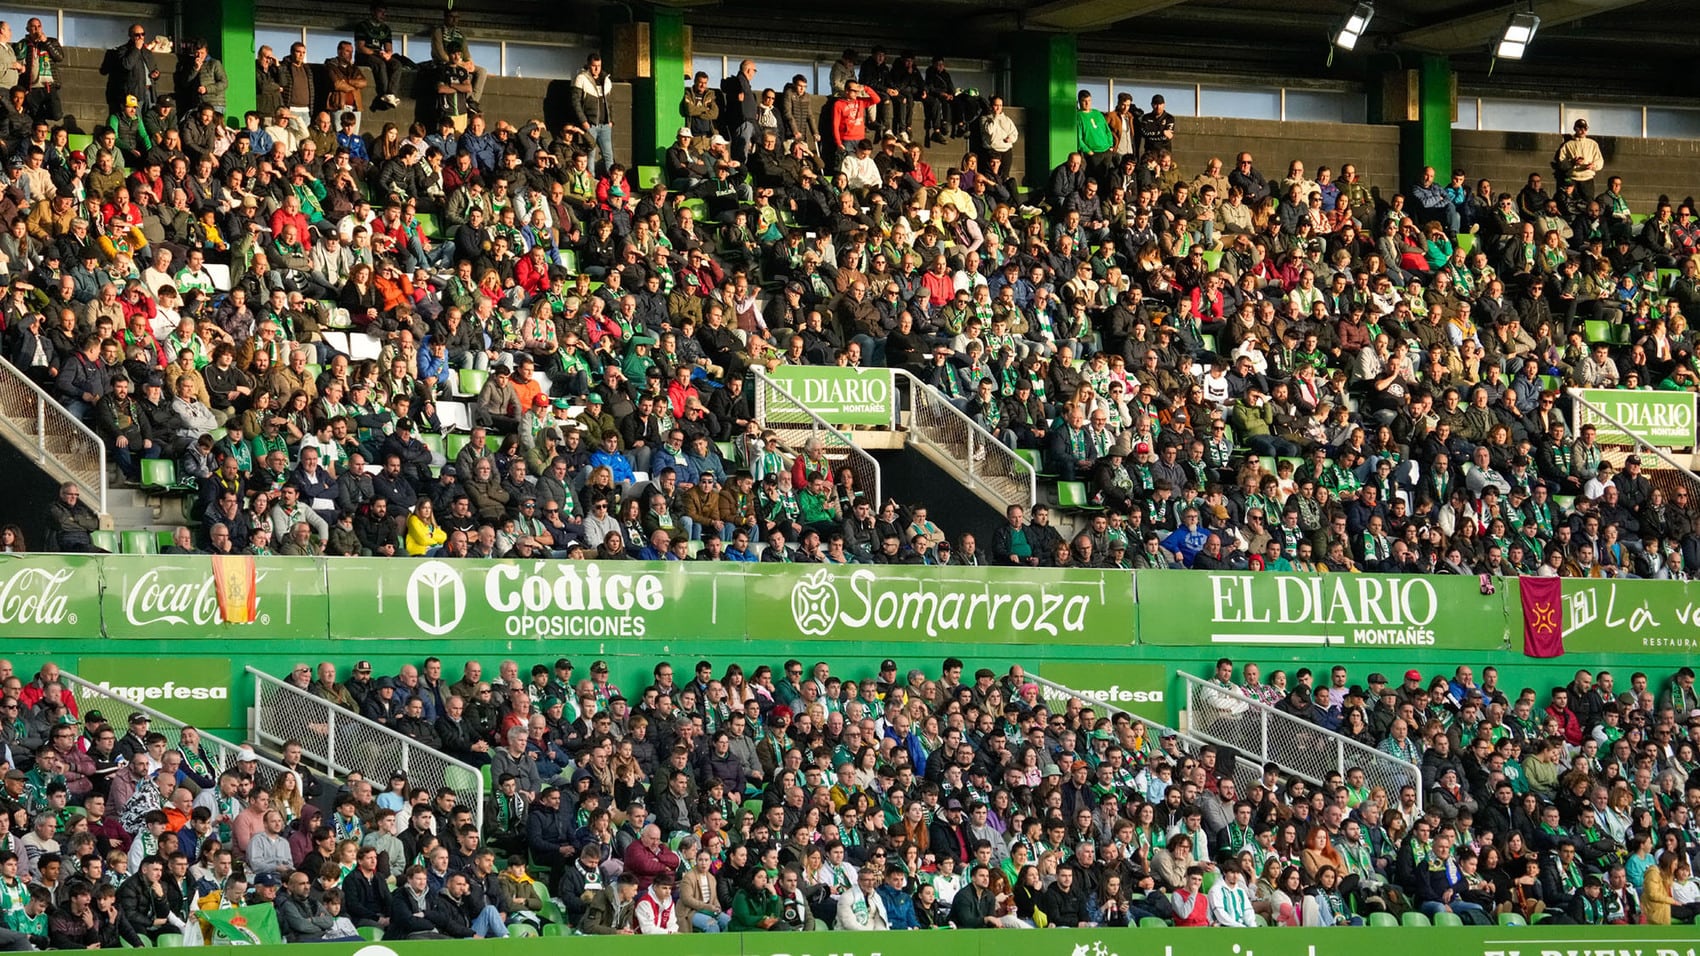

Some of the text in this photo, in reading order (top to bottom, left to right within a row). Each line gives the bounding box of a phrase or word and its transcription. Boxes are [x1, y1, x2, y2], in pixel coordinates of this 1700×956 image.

[770, 378, 887, 405] EL DIARIO
[1615, 402, 1691, 428] DIARIO
[485, 562, 664, 612] Códice
[1208, 575, 1438, 626] EL DIARIO
[840, 569, 1090, 637] Somarroza
[1605, 583, 1661, 632] La
[505, 615, 646, 636] OPOSICIONES
[1353, 625, 1435, 645] MONTAÑÉS
[82, 681, 228, 704] Magefesa
